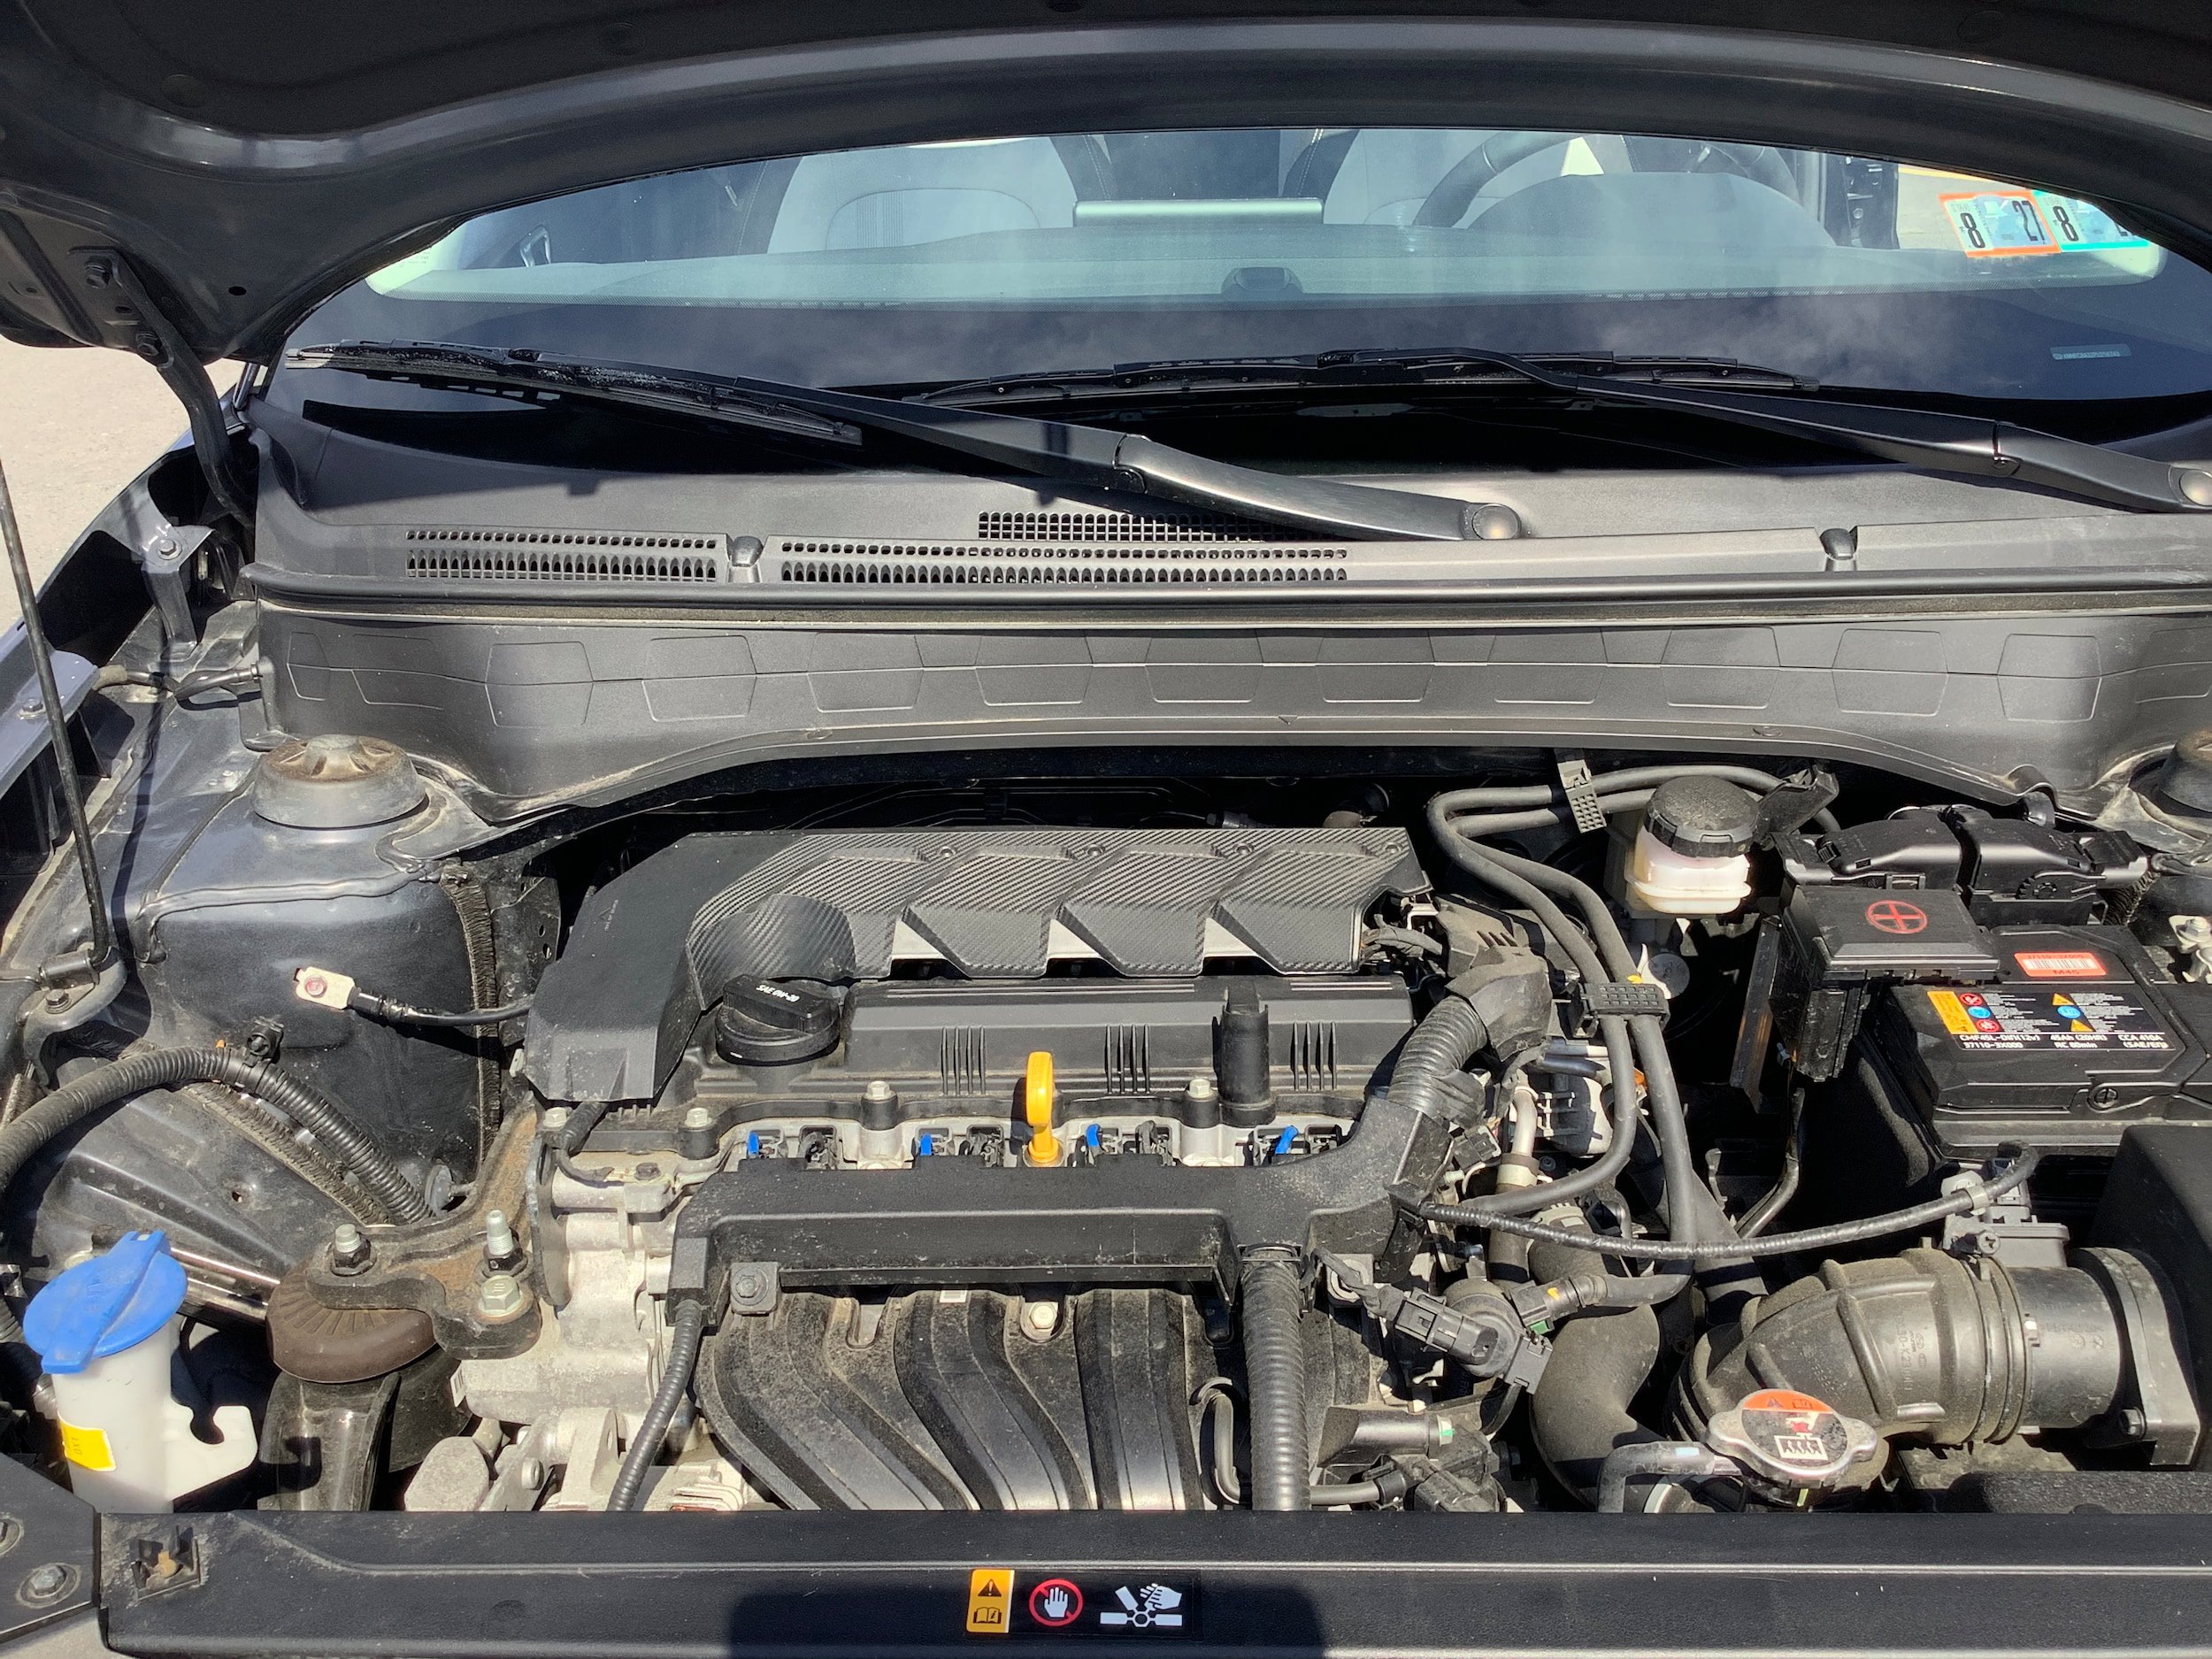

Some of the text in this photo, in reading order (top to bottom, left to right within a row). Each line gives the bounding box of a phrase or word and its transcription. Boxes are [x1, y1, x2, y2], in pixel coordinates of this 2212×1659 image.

[1960, 211, 1985, 249] 8
[2053, 205, 2079, 242] 8
[756, 984, 800, 1002] SAE 0W-20
